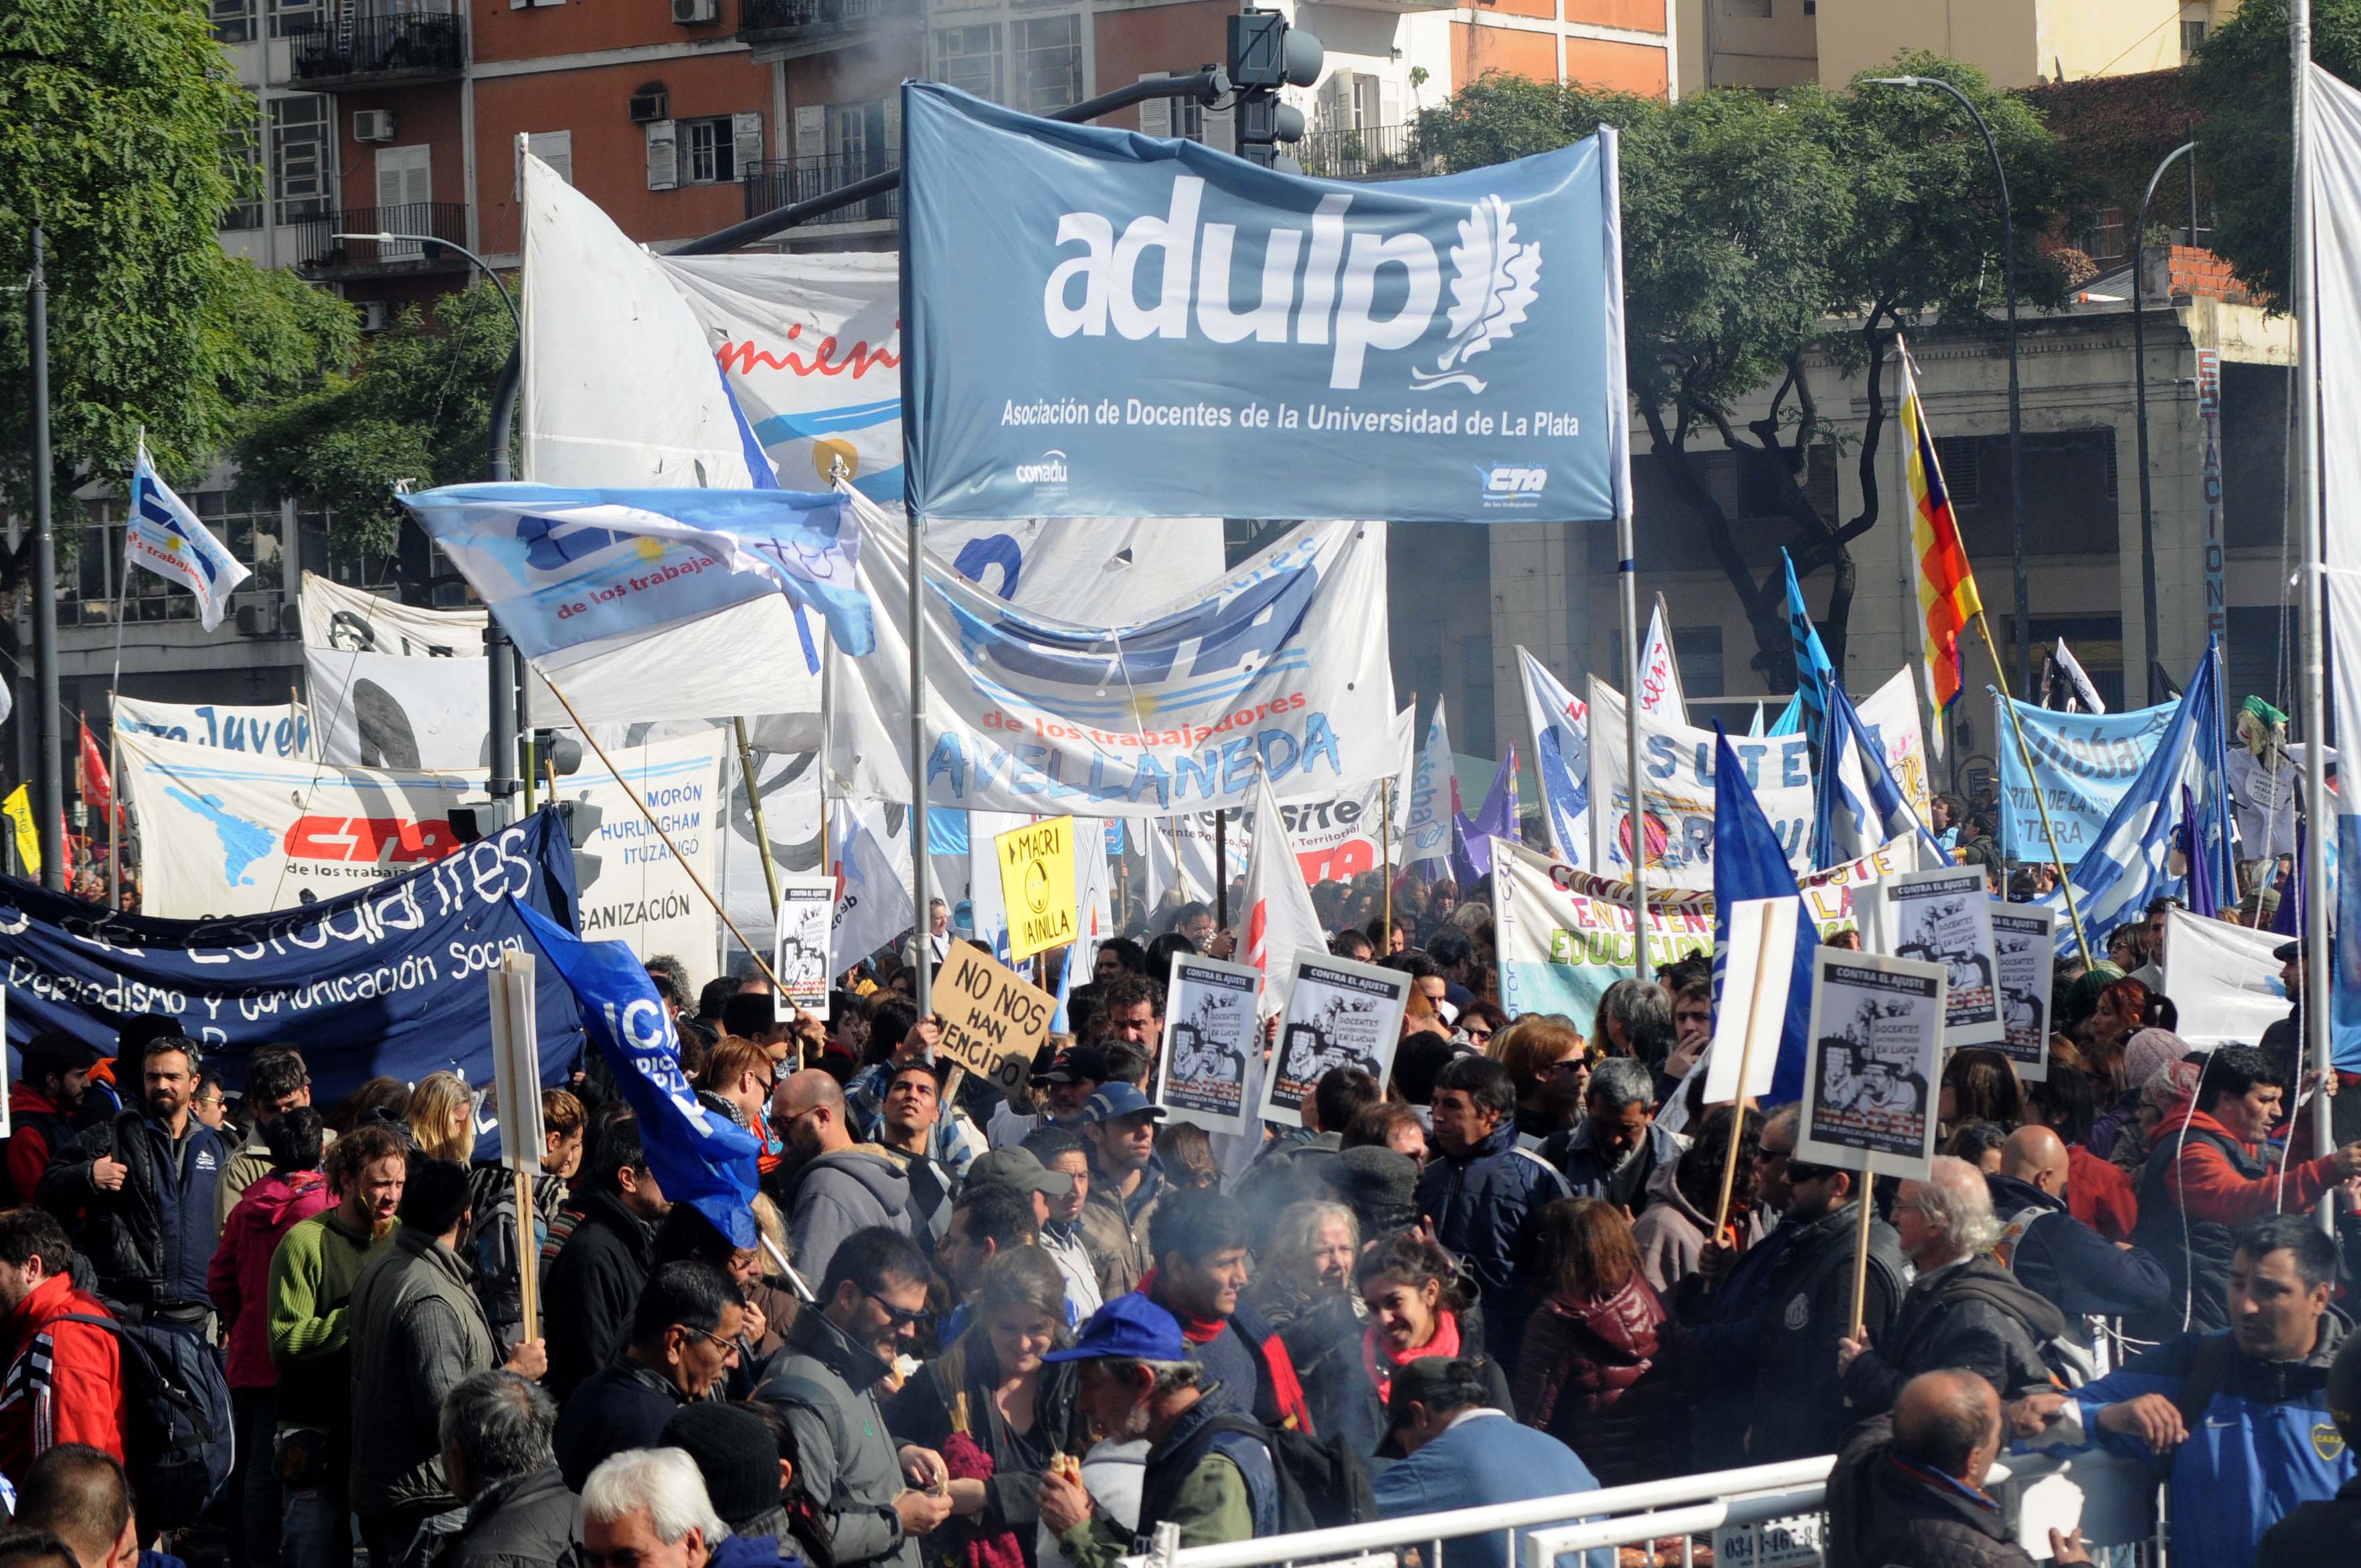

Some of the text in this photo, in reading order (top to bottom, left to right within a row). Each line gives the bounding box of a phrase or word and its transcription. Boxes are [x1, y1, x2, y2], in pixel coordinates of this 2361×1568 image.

[1044, 175, 1442, 389] adulp
[1001, 398, 1579, 438] Asociación de Docentes de la Universidad de La Plata
[1016, 459, 1068, 483] conadu
[1488, 468, 1547, 491] CTA
[557, 602, 588, 620] de
[590, 584, 626, 606] los
[983, 692, 1307, 748] de los trabajadores
[928, 711, 1341, 810] AVELLANEDA
[647, 782, 702, 808] MORÓN
[2048, 789, 2065, 811] DE
[600, 812, 700, 841] HURLINGHAM
[1298, 824, 1361, 847] Territorial
[624, 834, 699, 865] ITUZAINGÓ
[1019, 827, 1060, 861] MACRI
[287, 862, 309, 875] de
[315, 864, 340, 877] los
[1898, 880, 1933, 895] CONTRA
[1933, 881, 1945, 891] EL
[1945, 878, 1971, 891] AJUSTE
[1571, 897, 1615, 931] EN
[1811, 885, 1854, 920] LA
[2012, 920, 2038, 930] AJUSTE
[1186, 967, 1215, 981] CONTRA
[1215, 972, 1223, 982] EL
[1223, 973, 1247, 986] AJUSTE
[1310, 967, 1348, 983] CONTRA
[1348, 976, 1359, 986] EL
[1359, 978, 1391, 993] AJUSTE
[1836, 966, 1877, 982] CONTRA
[1878, 972, 1890, 984] EL
[1891, 974, 1926, 990] AJUSTE
[955, 958, 1046, 1037] NO NOS
[966, 1007, 1008, 1044] HAN
[1274, 1090, 1287, 1099] CON
